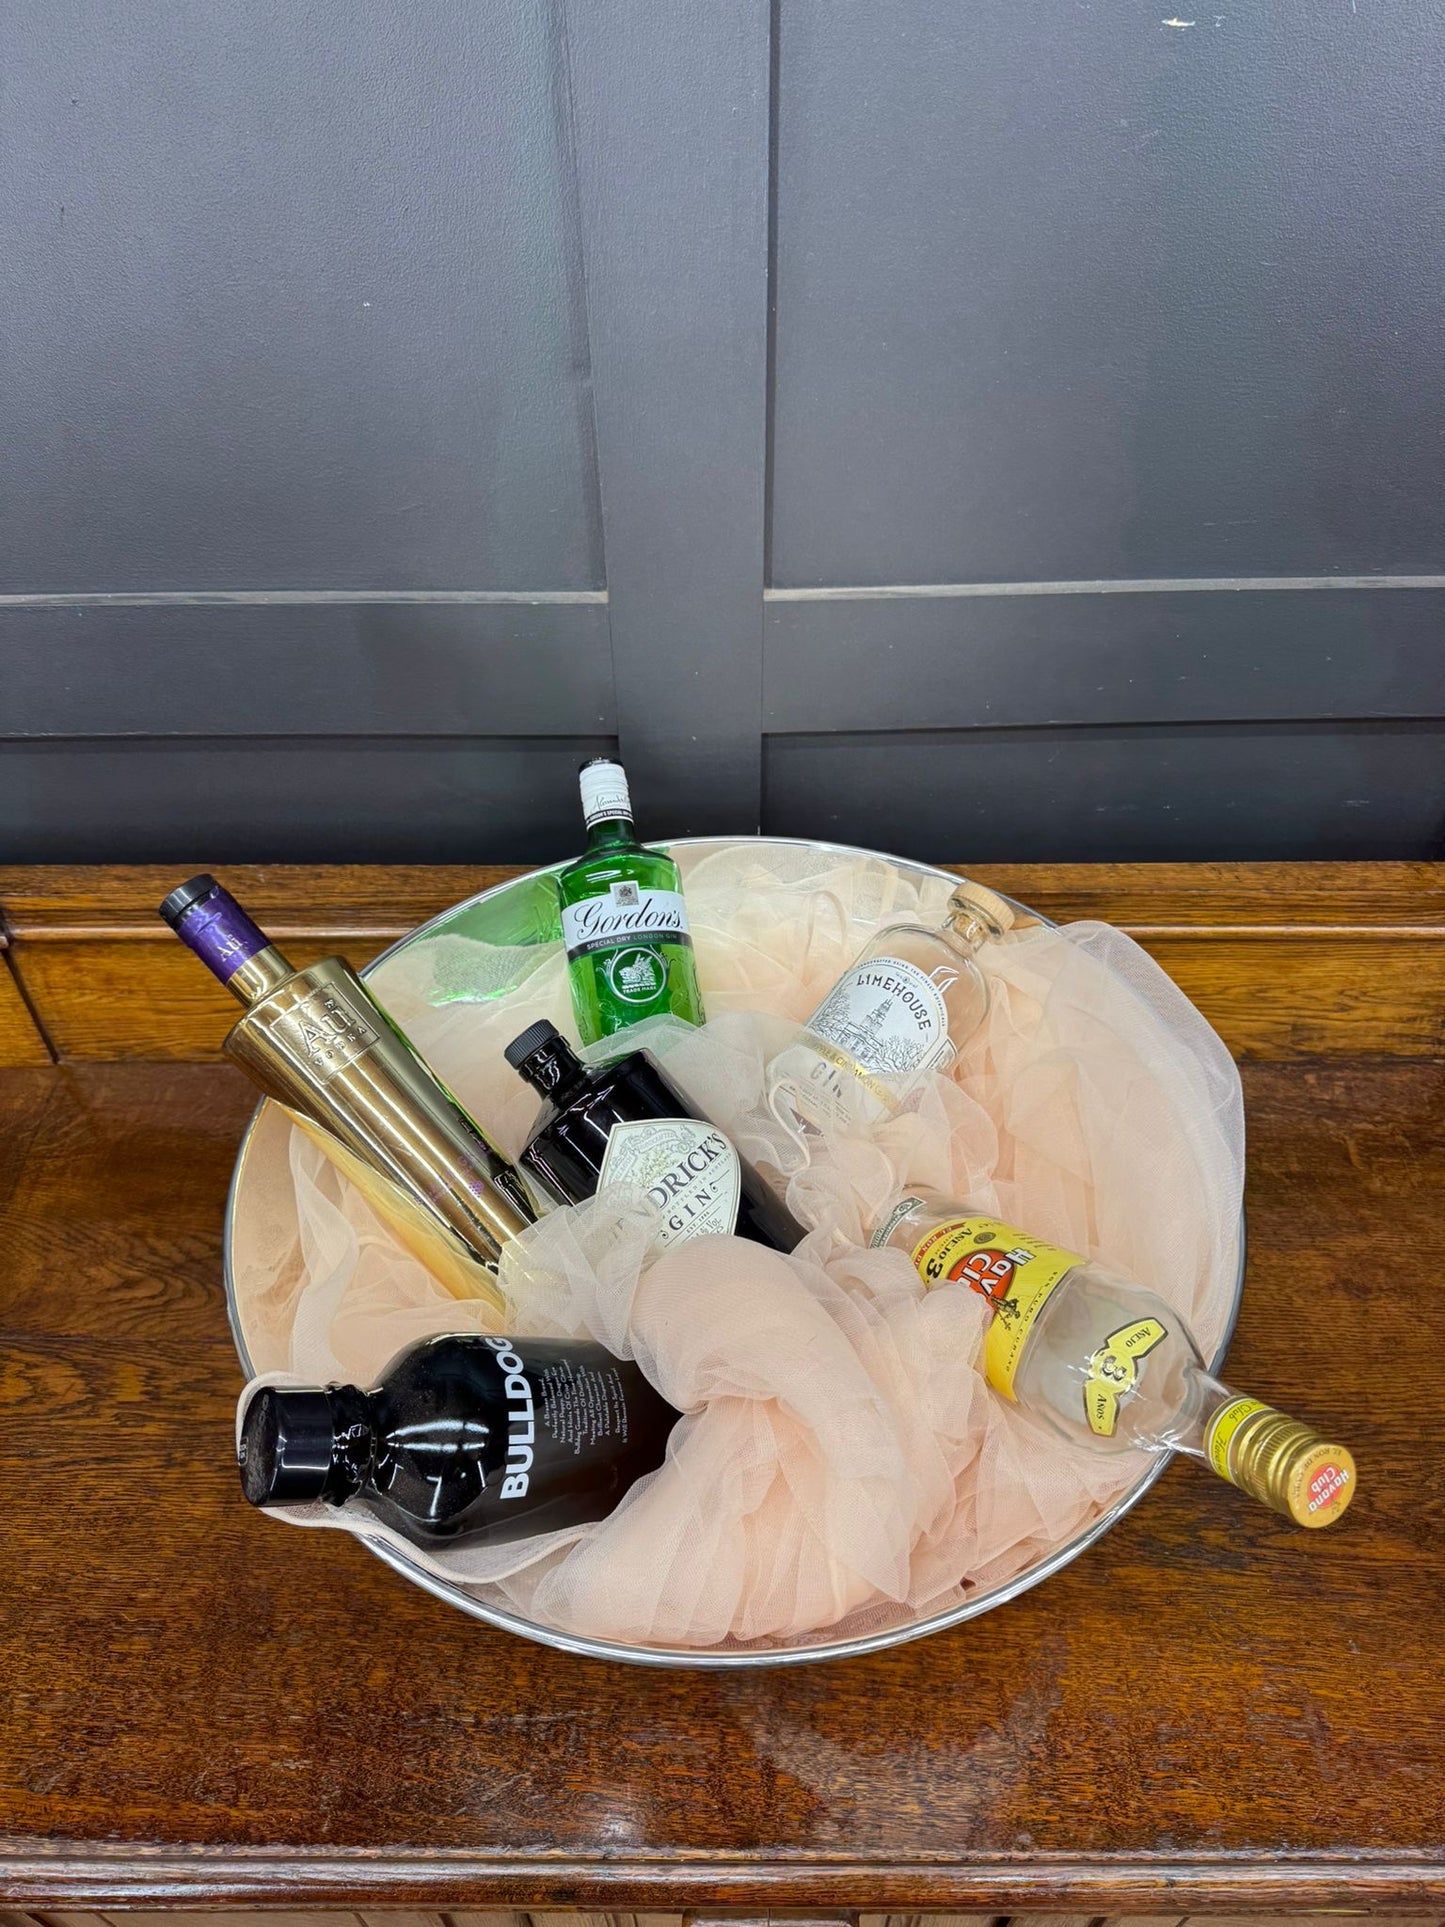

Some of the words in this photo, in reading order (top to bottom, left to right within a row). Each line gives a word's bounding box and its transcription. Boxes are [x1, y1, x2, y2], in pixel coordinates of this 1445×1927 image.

[574, 898, 683, 940] Gordon's
[586, 938, 615, 950] SPECIAL
[615, 935, 631, 944] DRY
[632, 932, 664, 940] LONDON
[857, 973, 932, 1031] LIMEHOUSE
[313, 1026, 368, 1067] VODKA
[669, 1188, 712, 1231] GIN
[921, 1235, 938, 1252] RON
[926, 1258, 943, 1279] 3
[977, 1246, 1037, 1299] Hav
[485, 1335, 534, 1500] BULLDOG
[1226, 1403, 1252, 1421] Club
[1306, 1468, 1350, 1513] Havana
[1311, 1466, 1336, 1494] Club
